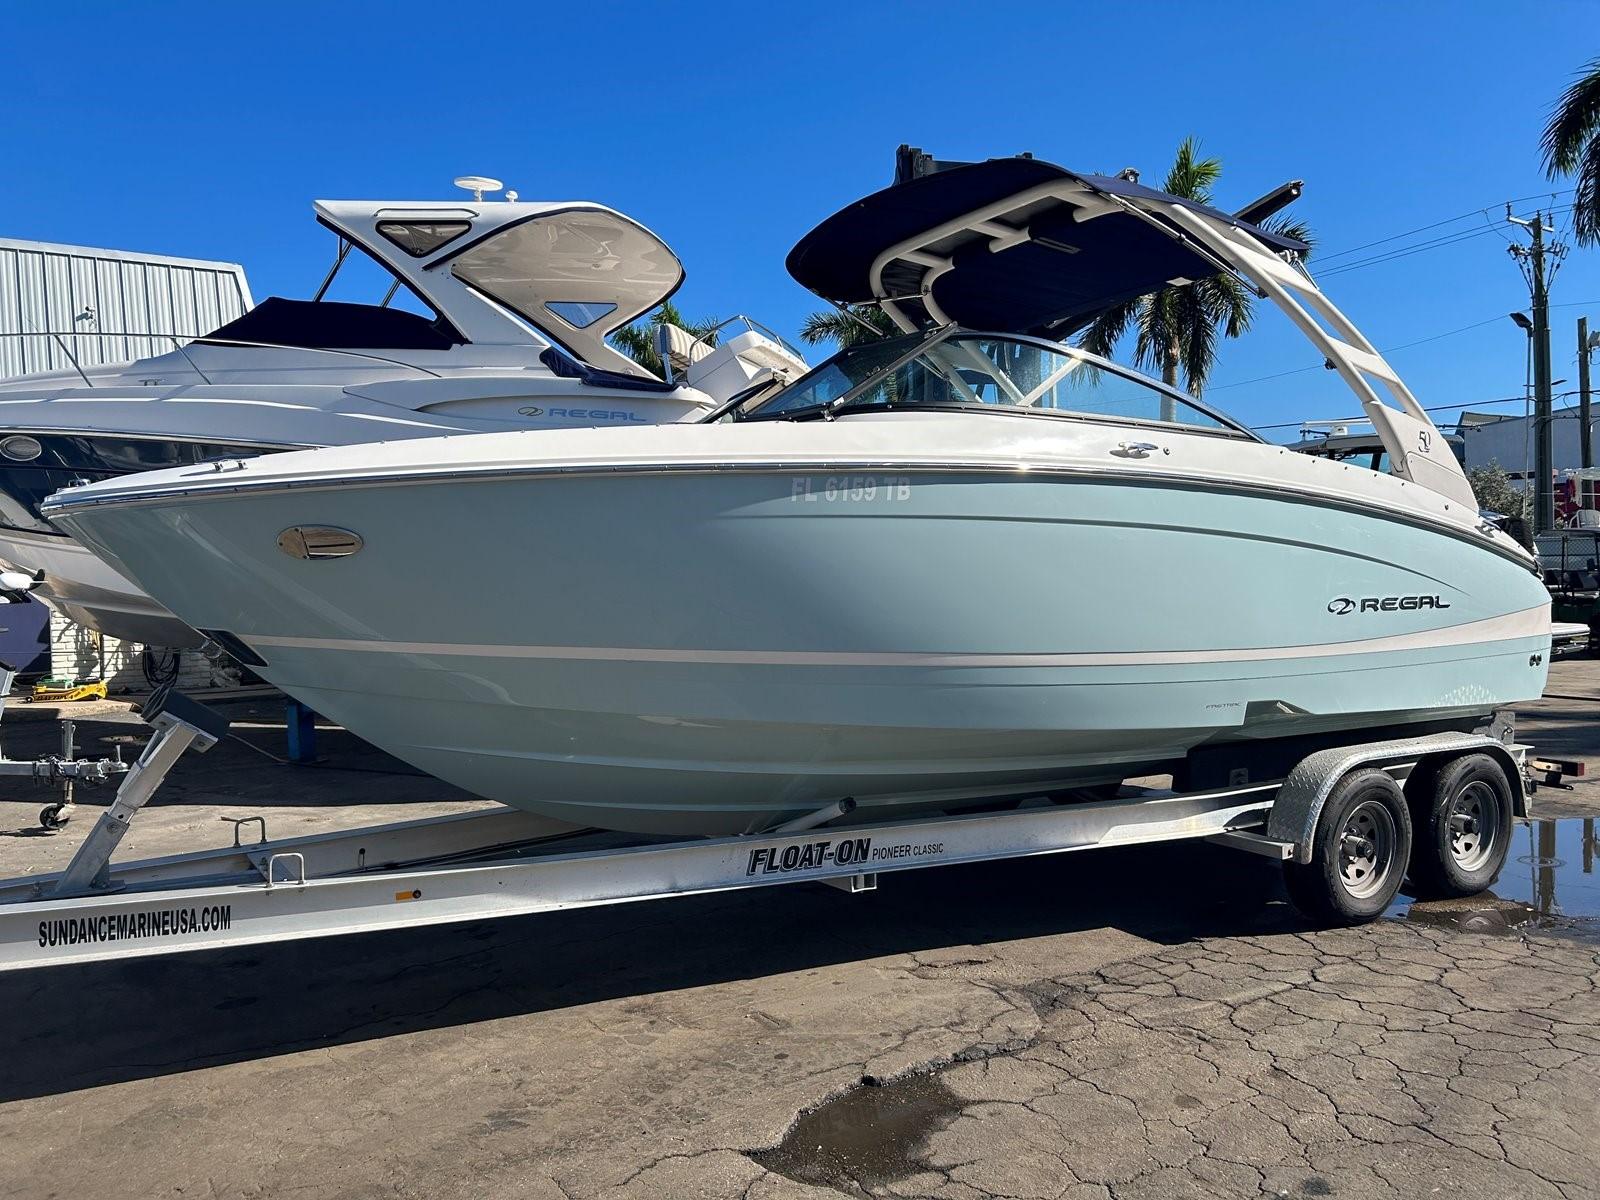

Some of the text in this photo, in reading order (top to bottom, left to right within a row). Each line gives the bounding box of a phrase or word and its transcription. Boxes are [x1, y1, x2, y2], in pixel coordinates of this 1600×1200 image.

[549, 407, 647, 422] REGAL
[791, 476, 911, 502] FL 6159 TB
[1360, 595, 1451, 613] REGAL
[746, 837, 944, 877] FLOAT-ON PIONEER CLASSIC
[38, 905, 231, 948] SUNDANCEMARINEUSA.COM
